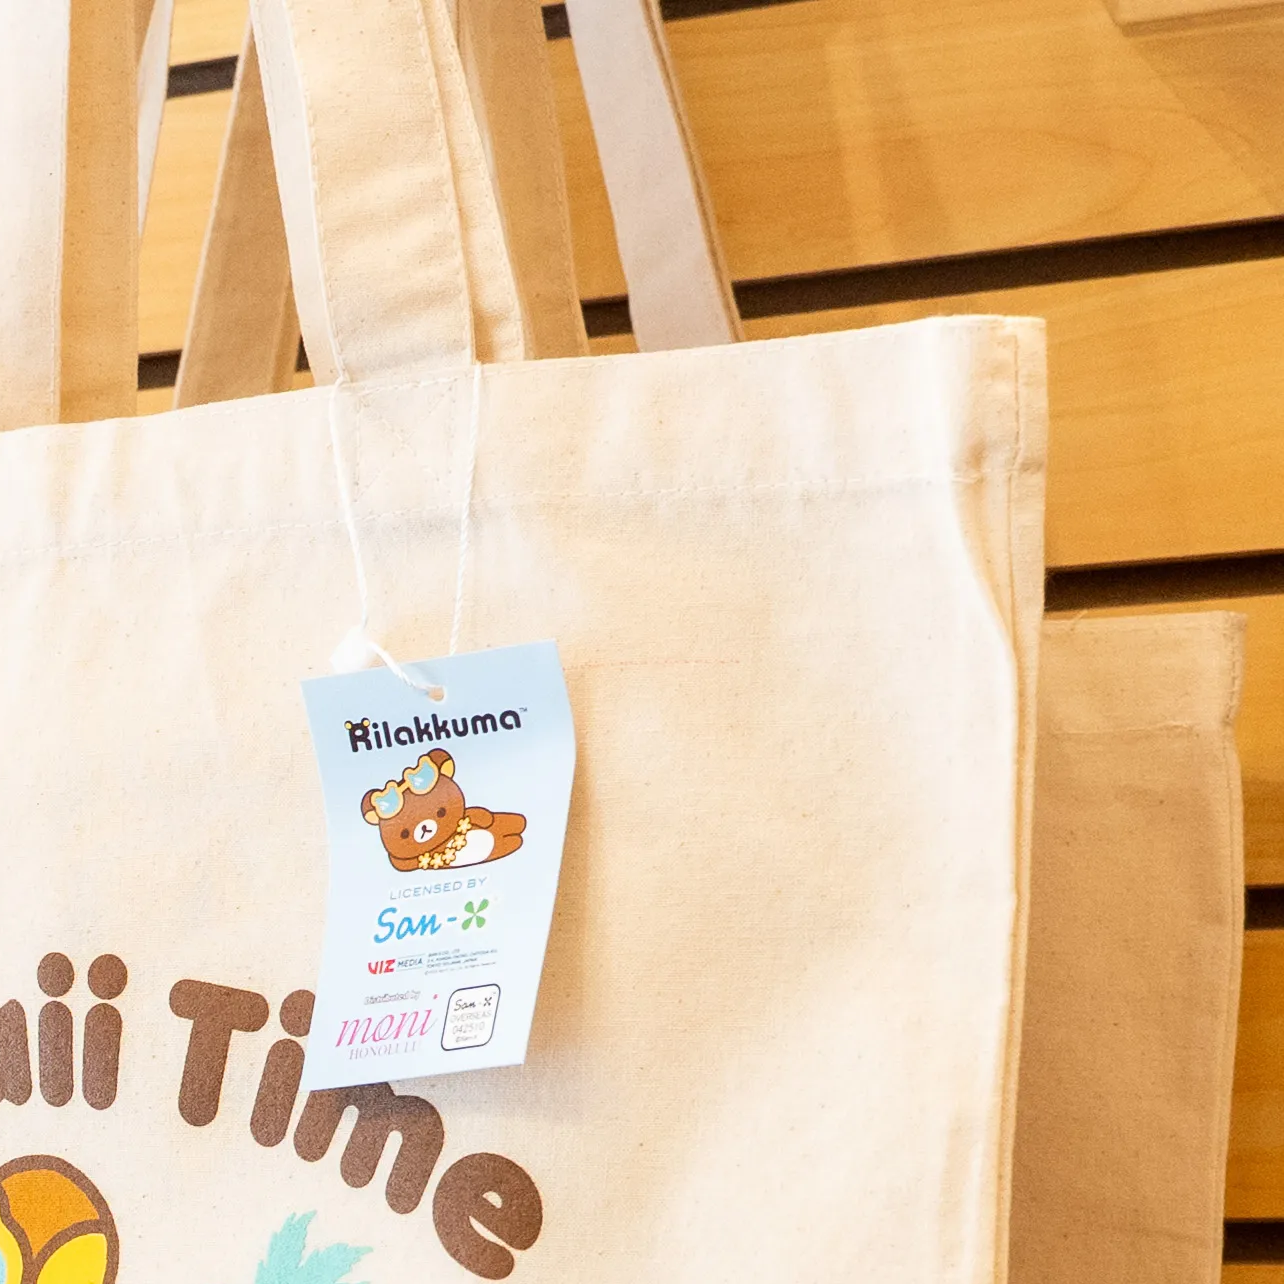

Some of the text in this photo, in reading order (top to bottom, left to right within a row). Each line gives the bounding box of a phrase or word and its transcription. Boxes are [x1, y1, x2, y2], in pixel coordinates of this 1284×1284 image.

[344, 709, 522, 753] Rilakkuma
[389, 876, 488, 901] LICENSED BY
[367, 958, 397, 975] VIZ
[397, 957, 424, 969] MEDIA
[335, 993, 439, 1048] moni
[168, 978, 544, 1281] Time
